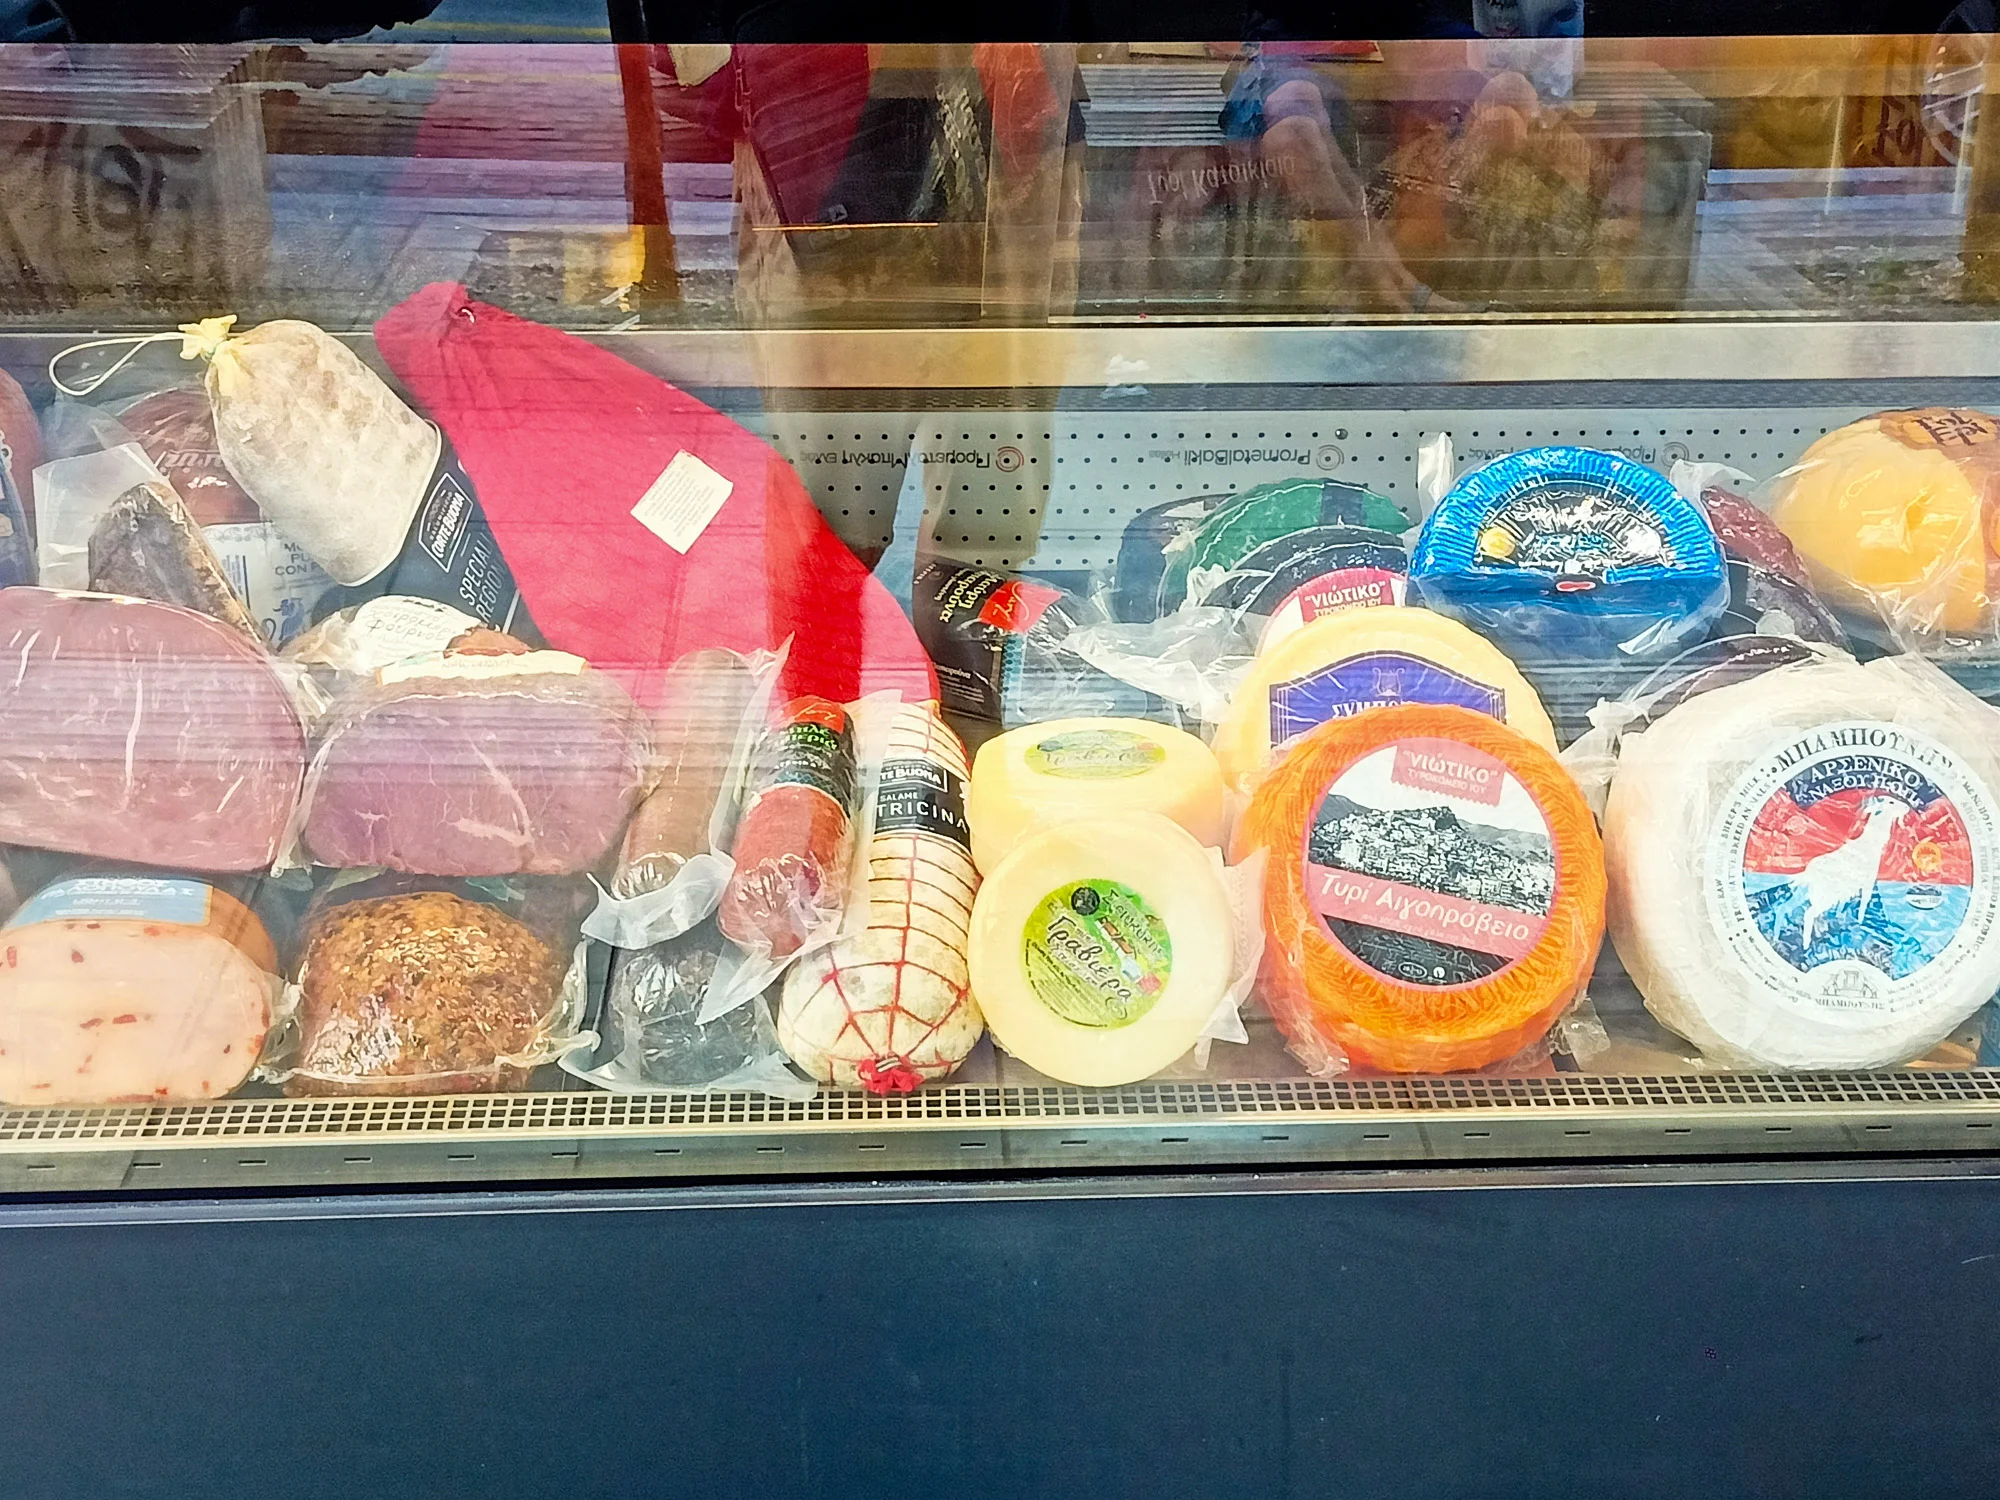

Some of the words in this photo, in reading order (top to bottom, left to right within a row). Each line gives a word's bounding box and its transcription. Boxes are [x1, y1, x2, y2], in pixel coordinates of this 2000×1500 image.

[459, 525, 491, 607] SPECIALI
[475, 559, 505, 623] REGION
[879, 791, 918, 802] SALAME
[1811, 757, 1922, 788] ΑΡΣΕΝΙΚΟ
[876, 801, 968, 834] TRICINA
[1321, 872, 1370, 905] Τυρί
[1375, 888, 1530, 942] Αιγοπρόβειο
[1047, 915, 1132, 1001] Γραβιέρα
